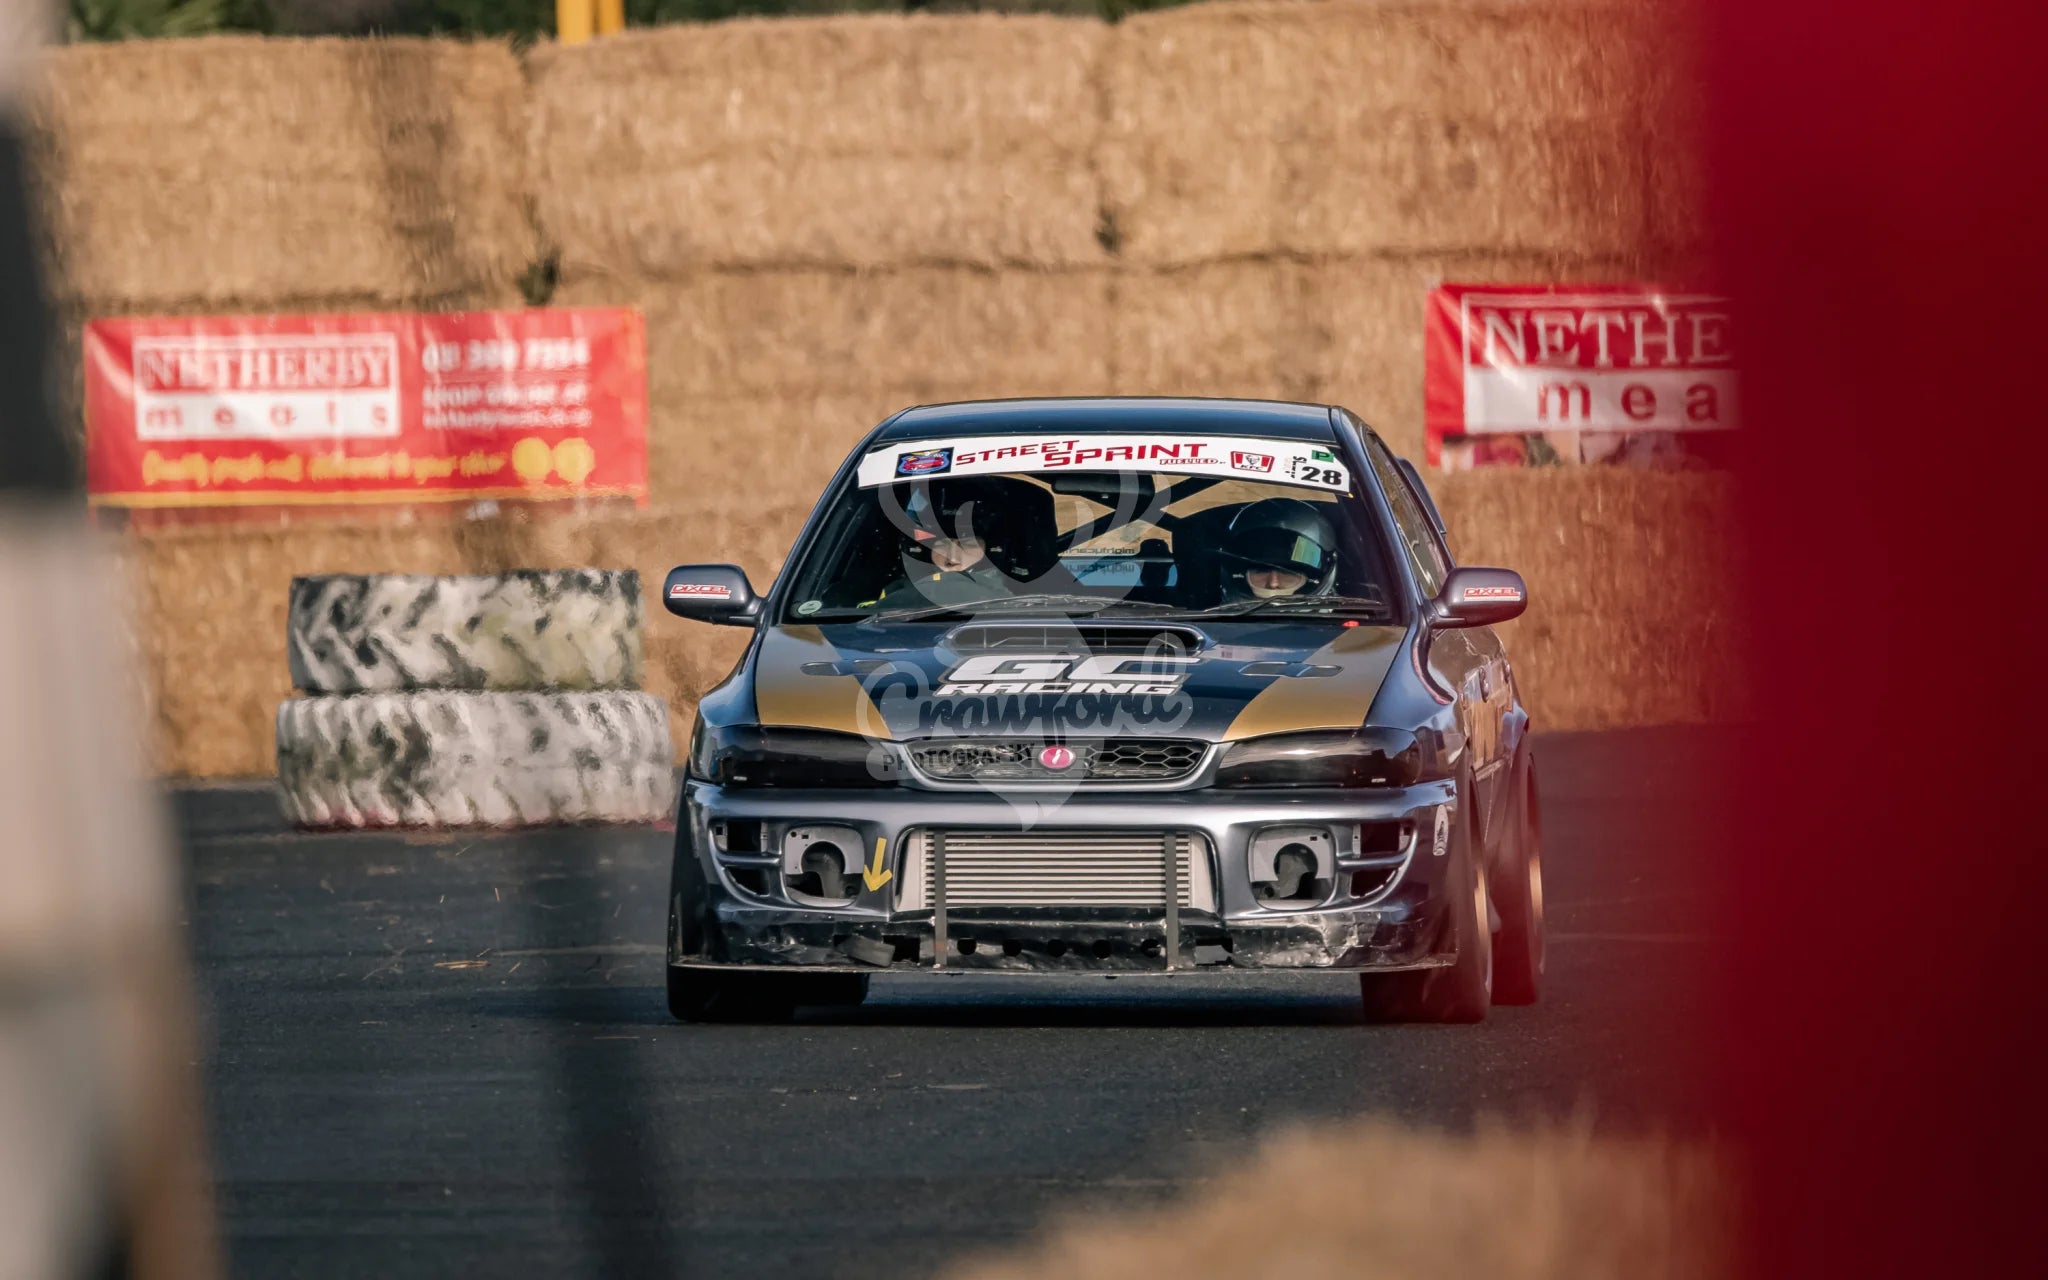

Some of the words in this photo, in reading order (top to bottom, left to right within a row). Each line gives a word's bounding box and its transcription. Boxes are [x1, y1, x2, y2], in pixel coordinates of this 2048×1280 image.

[1479, 309, 1731, 367] NETHE
[141, 349, 391, 388] NETHERBY
[1538, 381, 1720, 422] mea
[955, 440, 1080, 466] STREET
[1044, 444, 1207, 467] SPRINT
[1301, 466, 1342, 485] 28
[671, 585, 730, 594] DIXCEL
[1465, 588, 1520, 597] DIXCEL
[948, 655, 1200, 682] GC
[934, 683, 1181, 696] RACING
